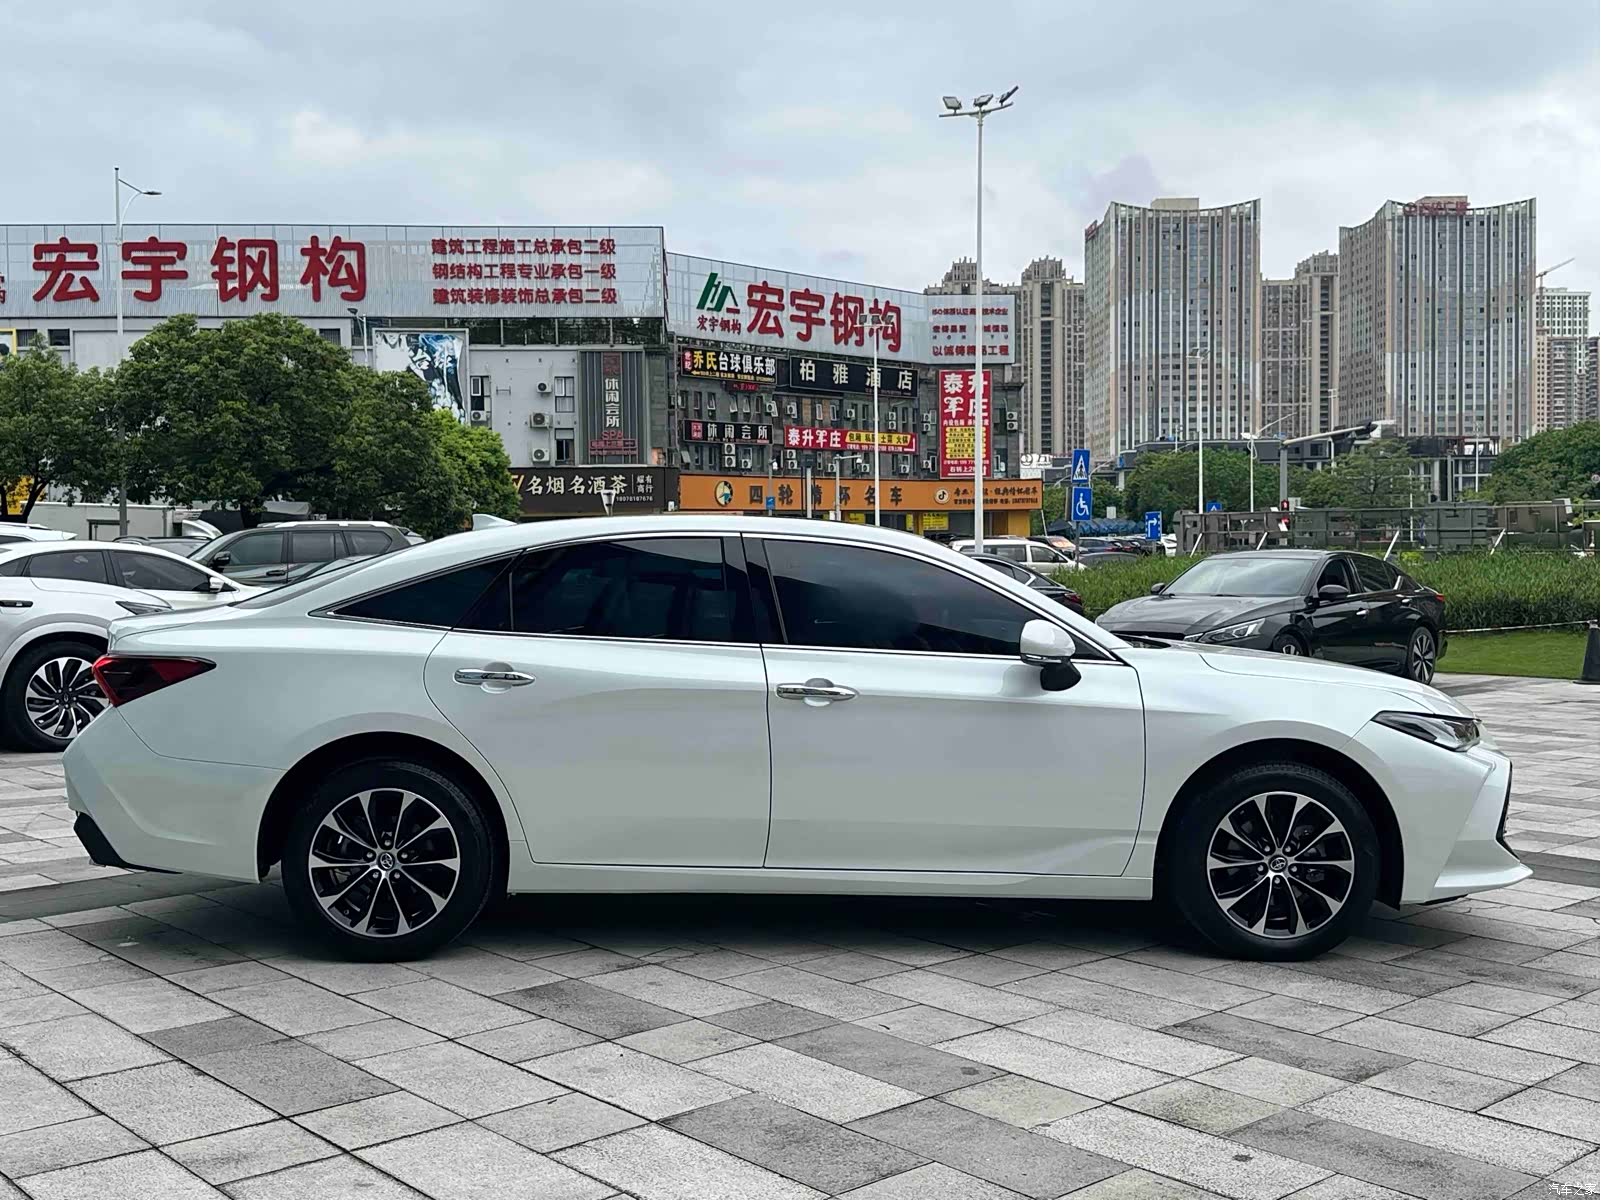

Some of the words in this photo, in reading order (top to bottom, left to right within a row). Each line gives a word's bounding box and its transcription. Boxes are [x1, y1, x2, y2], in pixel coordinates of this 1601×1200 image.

[431, 239, 616, 255] 建筑工程施工总承包二级
[32, 236, 366, 302] 宏宇钢构
[432, 263, 616, 280] 钢结构工程专业承包一级
[433, 288, 617, 305] 建筑装修装饰总承包二级
[696, 314, 742, 336] 宏宇钢构
[746, 280, 902, 352] 宏宇钢构
[693, 350, 776, 376] 乔氏台球俱乐部
[799, 359, 913, 391] 柏雅酒店
[605, 378, 620, 428] 休闲会所
[602, 430, 623, 440] SPA
[707, 423, 768, 440] 休闲会所
[526, 475, 628, 495] 名烟名酒茶
